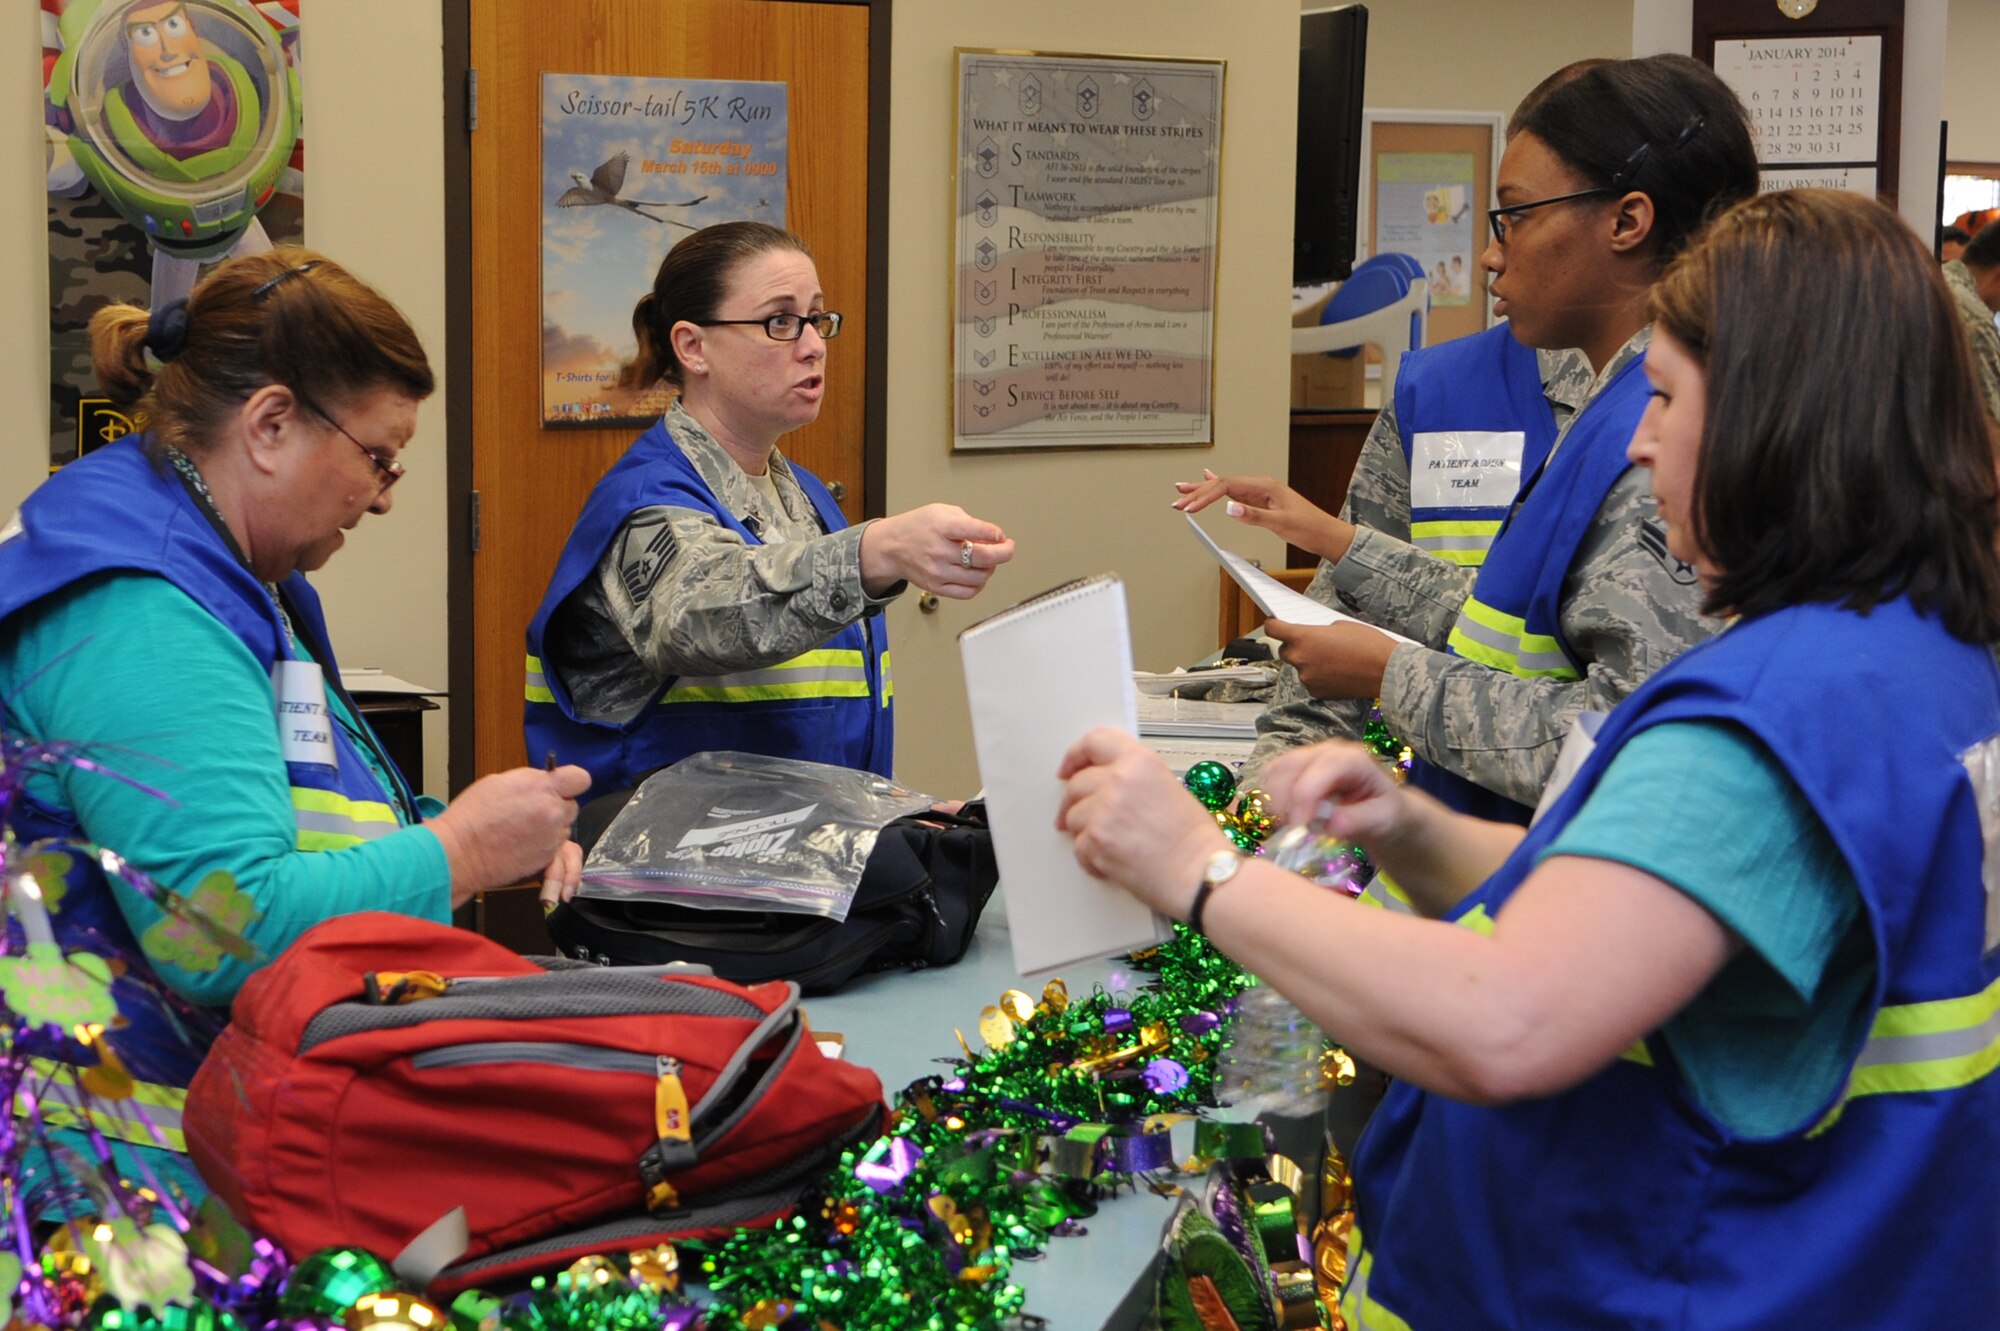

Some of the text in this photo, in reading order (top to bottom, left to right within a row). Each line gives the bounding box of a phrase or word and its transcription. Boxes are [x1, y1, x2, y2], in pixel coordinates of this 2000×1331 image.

[1749, 47, 1845, 60] JANUARY 2014
[1794, 69, 1861, 82] 1 2 3 4
[1752, 87, 1862, 100] 6 7 8 9 10 11
[561, 90, 773, 126] Scissor-tail 5K Run
[1770, 107, 1782, 119] 14
[1790, 107, 1802, 118] 15
[1810, 106, 1823, 117] 16
[1830, 106, 1843, 117] 17
[1850, 105, 1863, 117] 18
[1767, 125, 1780, 137] 21
[1788, 125, 1802, 136] 22
[1808, 124, 1822, 136] 23
[1828, 123, 1842, 135] 24
[1848, 123, 1862, 135] 25
[669, 138, 753, 159] Saturday
[1767, 143, 1781, 155] 28
[1787, 143, 1802, 154] 29
[1807, 142, 1822, 153] 30
[1827, 142, 1841, 153] 31
[641, 159, 687, 174] March
[691, 160, 722, 175] 15th
[726, 163, 740, 175] at
[1820, 179, 1846, 189] 2014
[1043, 333, 1081, 341] Professional
[595, 372, 609, 382] for
[1428, 459, 1469, 470] PATIENT
[1451, 479, 1480, 488] TEAM
[710, 828, 796, 858] Ziploc
